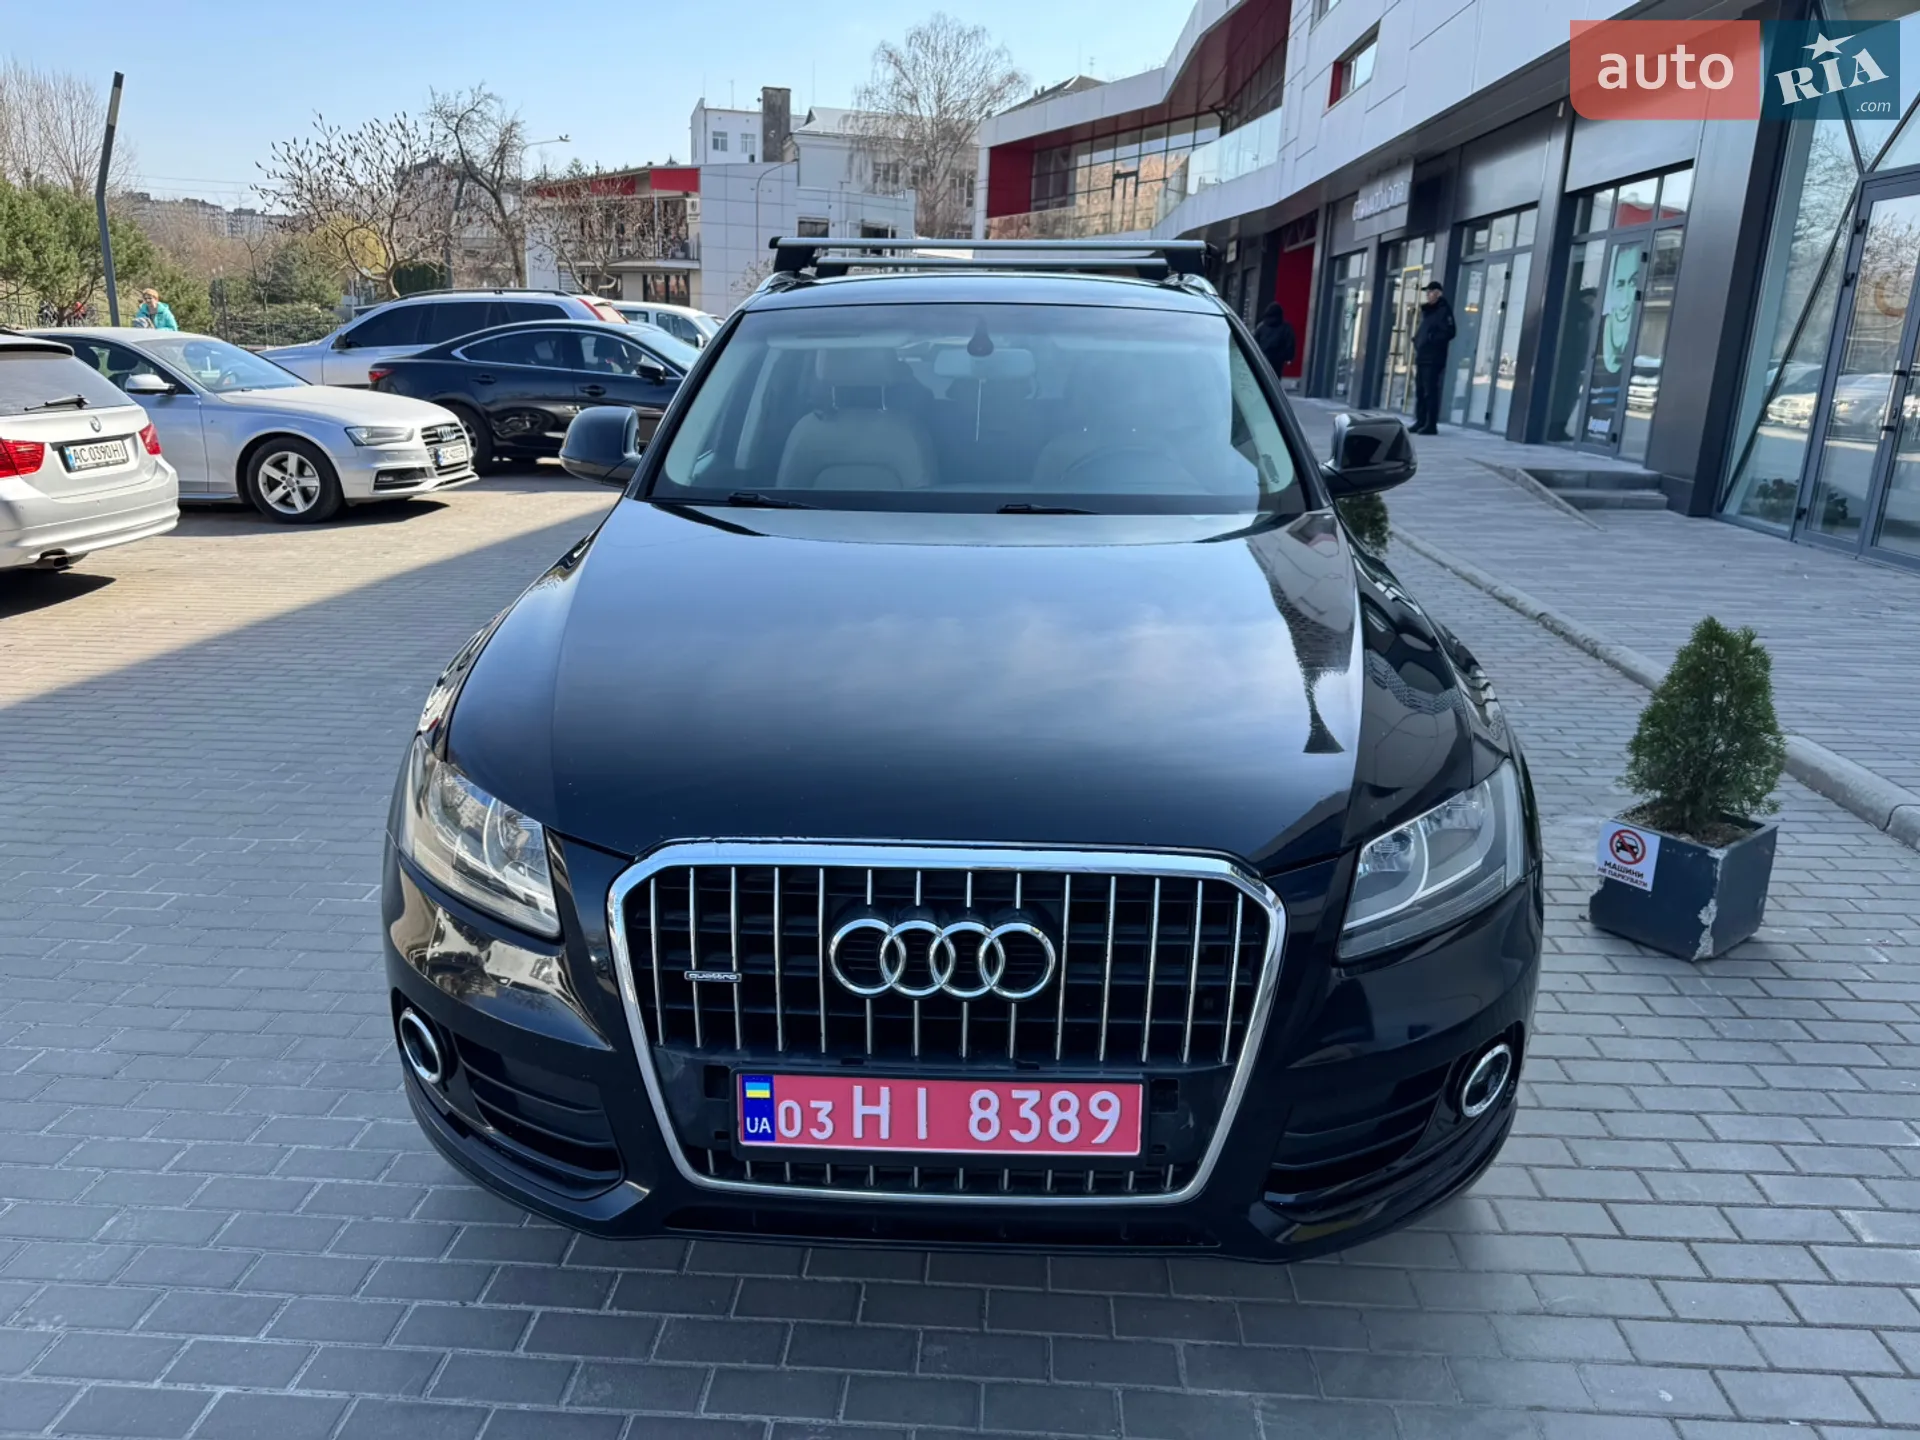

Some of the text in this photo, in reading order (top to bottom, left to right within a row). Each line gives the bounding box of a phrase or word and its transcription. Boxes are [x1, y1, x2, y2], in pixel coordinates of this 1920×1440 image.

[73, 448, 89, 463] AC
[1604, 860, 1644, 879] МАШИНИ
[1607, 869, 1648, 888] ПАРКУВАТИ
[745, 1116, 772, 1134] UA
[777, 1098, 836, 1140] 03
[968, 1088, 1121, 1144] 8389
